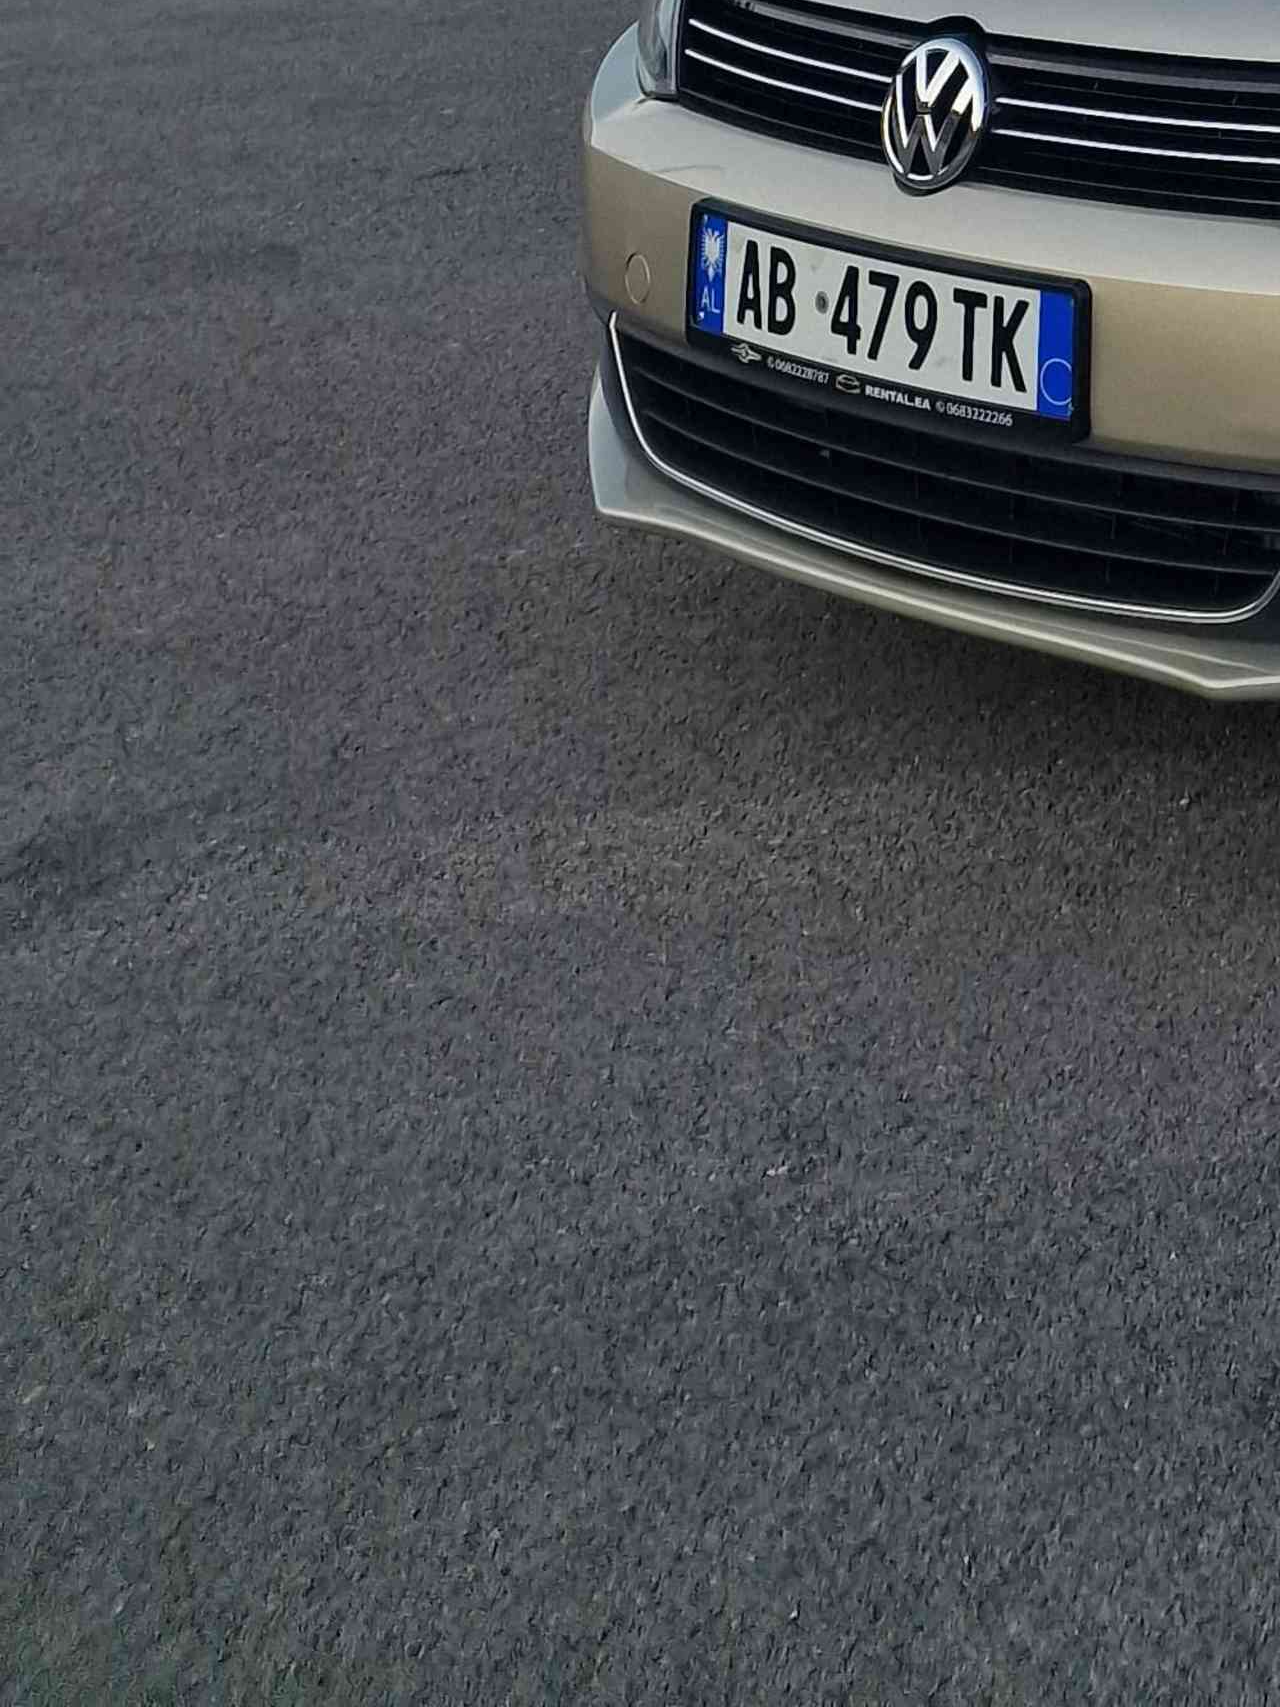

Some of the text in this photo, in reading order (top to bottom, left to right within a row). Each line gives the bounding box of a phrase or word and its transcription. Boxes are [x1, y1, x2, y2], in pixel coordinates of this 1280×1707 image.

[701, 285, 721, 314] AL
[736, 239, 1030, 393] AB 479 TK
